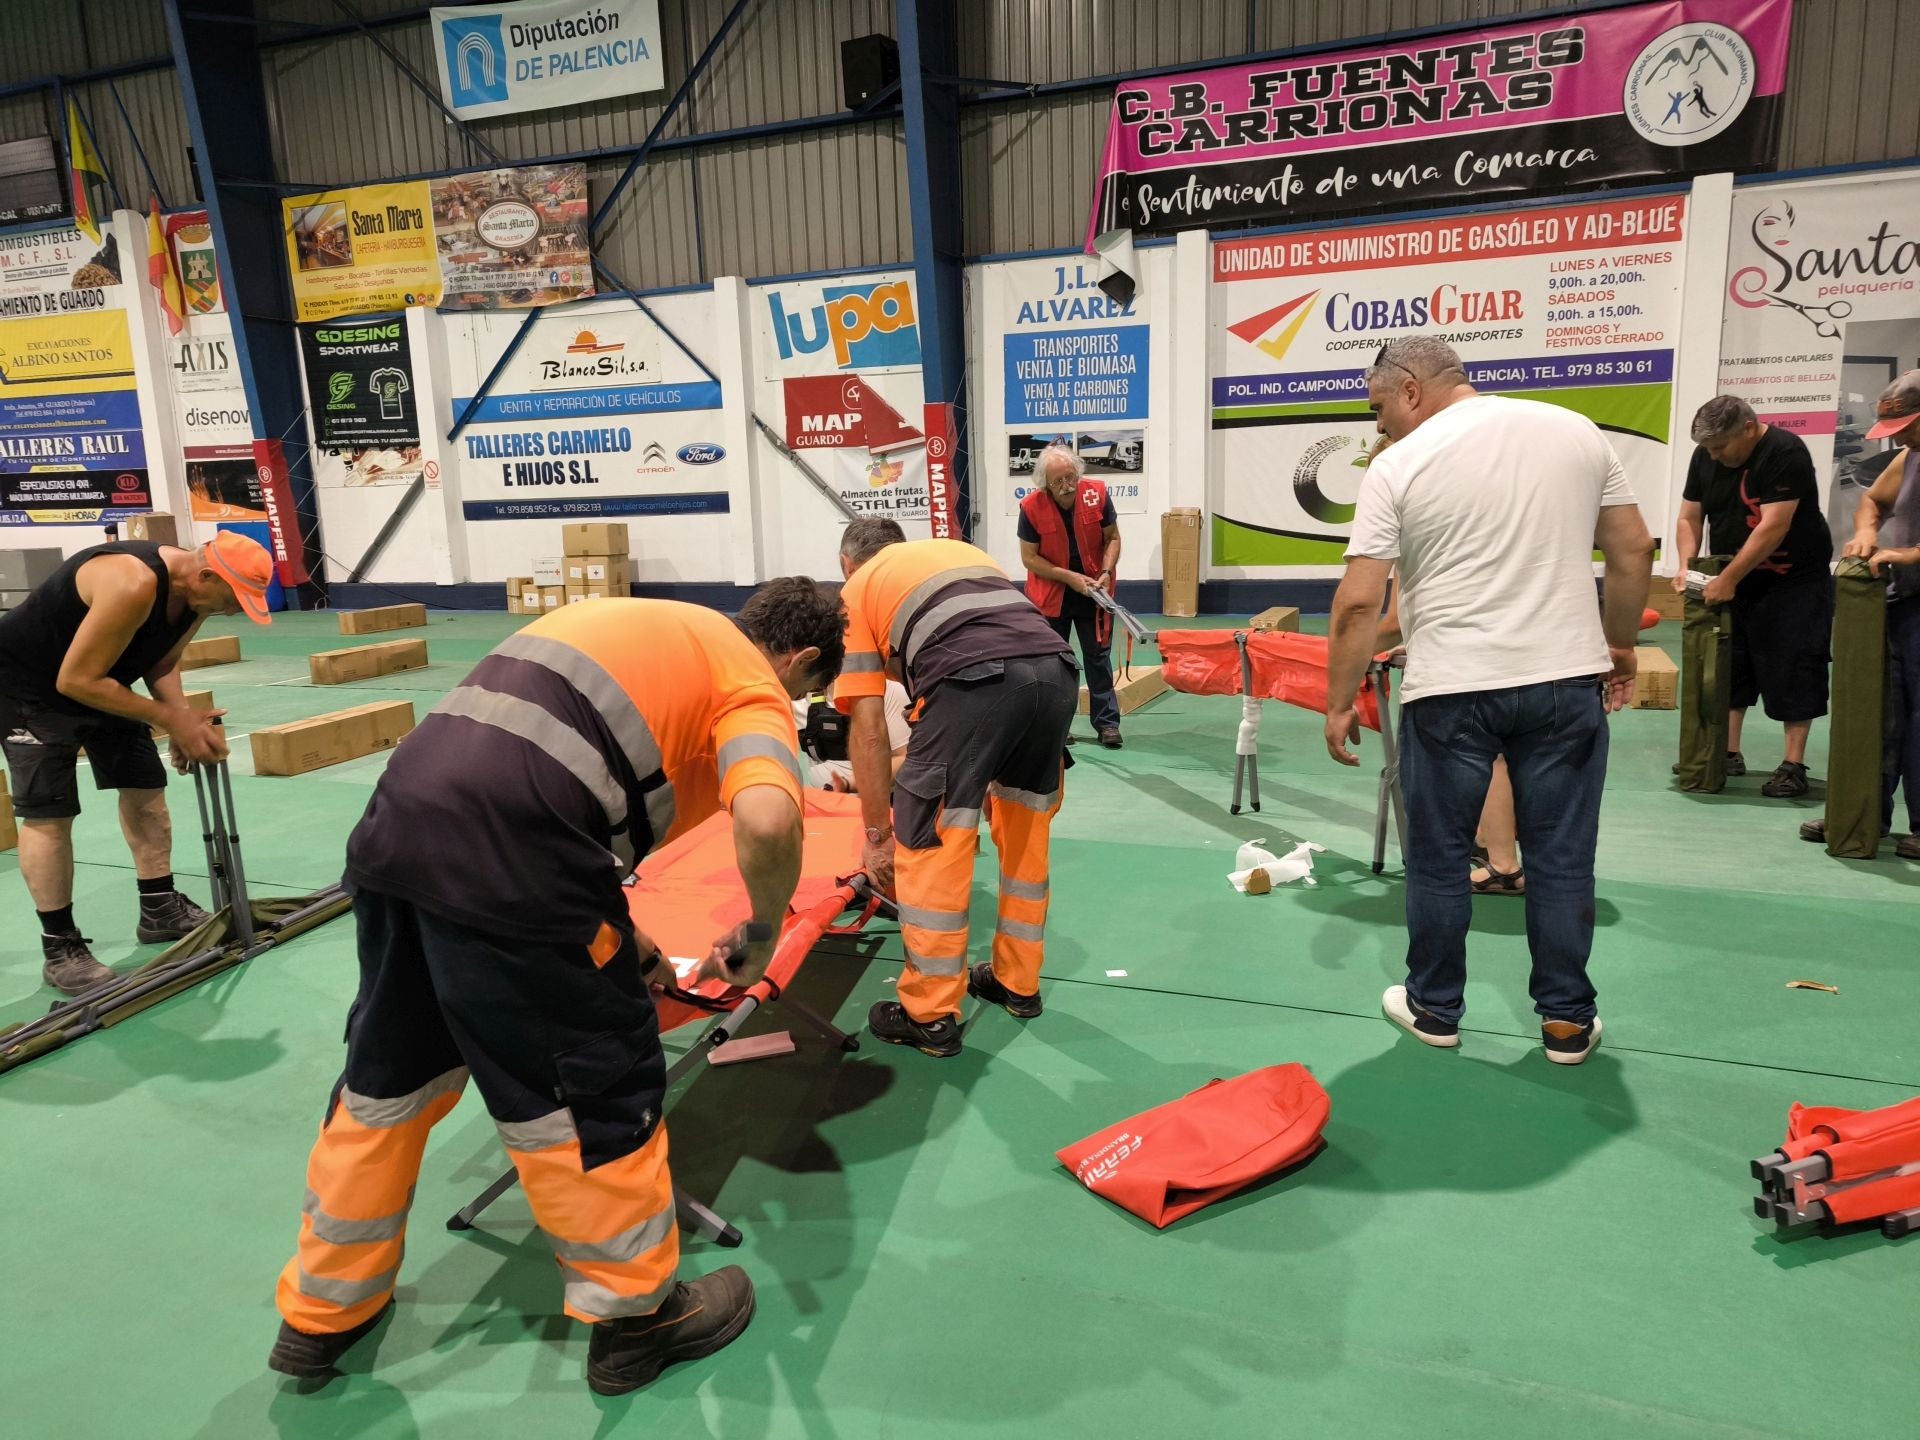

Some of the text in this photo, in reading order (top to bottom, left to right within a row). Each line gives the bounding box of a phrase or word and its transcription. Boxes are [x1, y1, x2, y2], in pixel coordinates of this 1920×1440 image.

[510, 9, 619, 50] Diputación
[515, 37, 650, 82] DE PALENCIA
[1704, 29, 1748, 86] CLUB BALONMANO
[1116, 26, 1585, 125] C.B. FUENTES
[1630, 53, 1654, 134] FUENTES CARRIONAS
[1137, 71, 1553, 158] CARRIONAS
[1137, 164, 1304, 225] Sentimiento
[1315, 166, 1359, 197] de
[1371, 165, 1442, 189] una
[1454, 147, 1600, 186] Comarca
[0, 209, 18, 220] CAL
[351, 205, 424, 236] Santa Marta
[0, 229, 82, 251] OMBUSTIBLES
[1219, 206, 1678, 273] UNIDAD DE SUMINISTRO DE GASÓLEO Y AD-BLUE
[1550, 251, 1673, 273] LUNES A VIERNES
[1730, 200, 1920, 308] Santa
[1054, 265, 1097, 295] J.L.
[1548, 271, 1646, 290] 9,00h. a 20,00h.
[1818, 278, 1914, 298] peluquería
[0, 288, 105, 317] MIENTO DE GUARDO
[1546, 304, 1644, 322] 9,00h. a 15,00h.
[315, 323, 400, 343] GDESING
[767, 280, 916, 368] lupa
[1546, 323, 1621, 338] DOMINGOS Y
[26, 338, 92, 350] EXCAVACIONES
[319, 342, 399, 356] SPORTWEAR
[1033, 334, 1119, 358] TRANSPORTES
[1325, 328, 1524, 352] COOPERATI RANSPORTES
[1546, 331, 1664, 349] FESTIVOS CERRADO
[12, 348, 113, 367] ALBINO SANTOS
[176, 339, 229, 372] AXIS
[1016, 354, 1136, 380] VENTA DE BIOMASA
[1719, 353, 1834, 366] TRATAMIENTOS CAPILARES
[1024, 378, 1129, 400] VENTA DE CARBONES
[1228, 383, 1256, 397] POL.
[1260, 382, 1285, 395] IND.
[1469, 364, 1529, 383] LENCIA).
[1533, 366, 1564, 379] TEL.
[1567, 363, 1593, 377] 979
[1595, 362, 1613, 375] 85
[1616, 361, 1633, 374] 30
[1636, 360, 1653, 373] 61
[1718, 373, 1837, 386] TRATAMIENTOS DE BELLEZA
[500, 389, 681, 413] VENTA Y REPARACIÓN DE VEHÍCULOS
[1024, 397, 1127, 417] Y LEÑA A DOMICILIO
[1773, 394, 1832, 403] PERMANENTES
[801, 413, 862, 432] MAP
[1778, 419, 1807, 428] MUJER
[0, 434, 129, 458] ALLERES RAUL
[465, 427, 632, 459] TALLERES CARMELO
[796, 434, 844, 446] GUARDO
[685, 445, 716, 462] Ford
[120, 478, 136, 488] KIA
[502, 460, 599, 487] E HIJOS S.L.
[841, 487, 923, 499] Almacén de frutas
[930, 463, 949, 538] MAPFR
[1105, 485, 1139, 497] 0.77.98
[72, 510, 97, 520] HORAS
[263, 487, 288, 562] MAPFRE
[1084, 1135, 1143, 1188] FERRI
